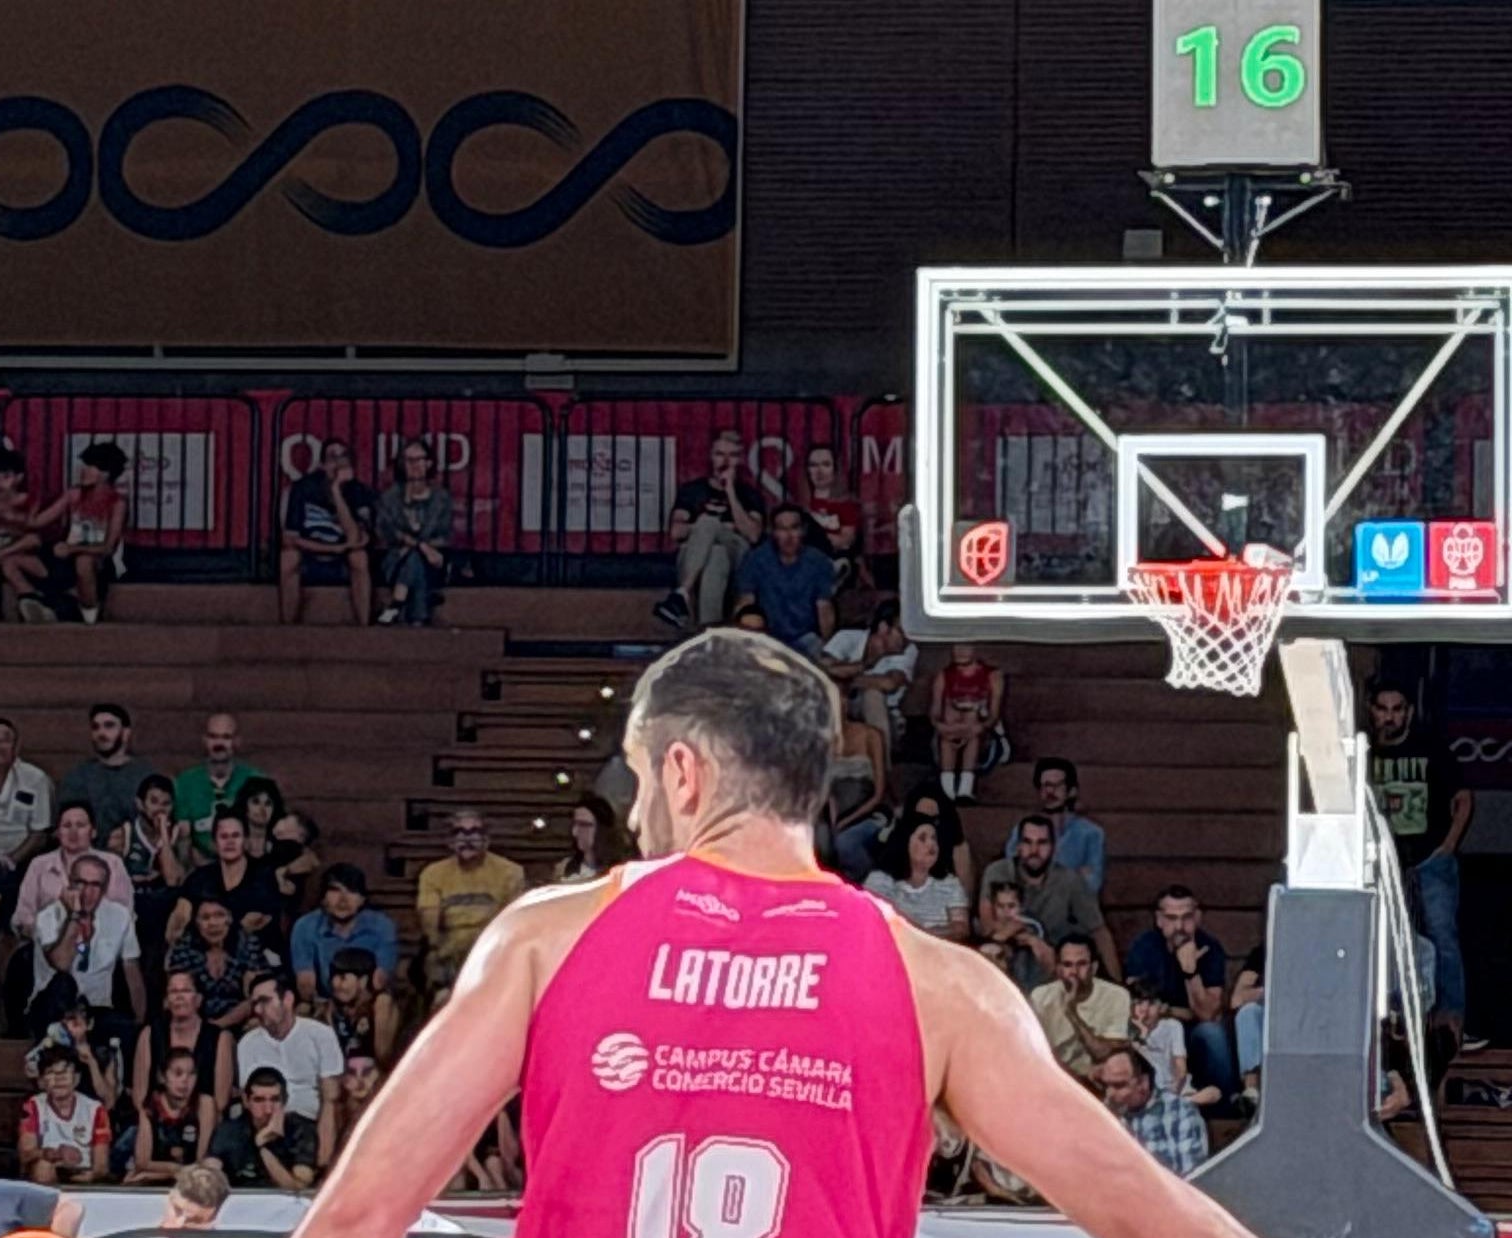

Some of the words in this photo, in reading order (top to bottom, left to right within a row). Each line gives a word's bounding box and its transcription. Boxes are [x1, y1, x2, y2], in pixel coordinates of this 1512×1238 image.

[1175, 25, 1305, 108] 16
[648, 943, 828, 1010] LATORRE
[653, 1045, 755, 1071] CAMPUS
[652, 1069, 766, 1095] COMERCIO
[766, 1075, 853, 1112] SEVILLA
